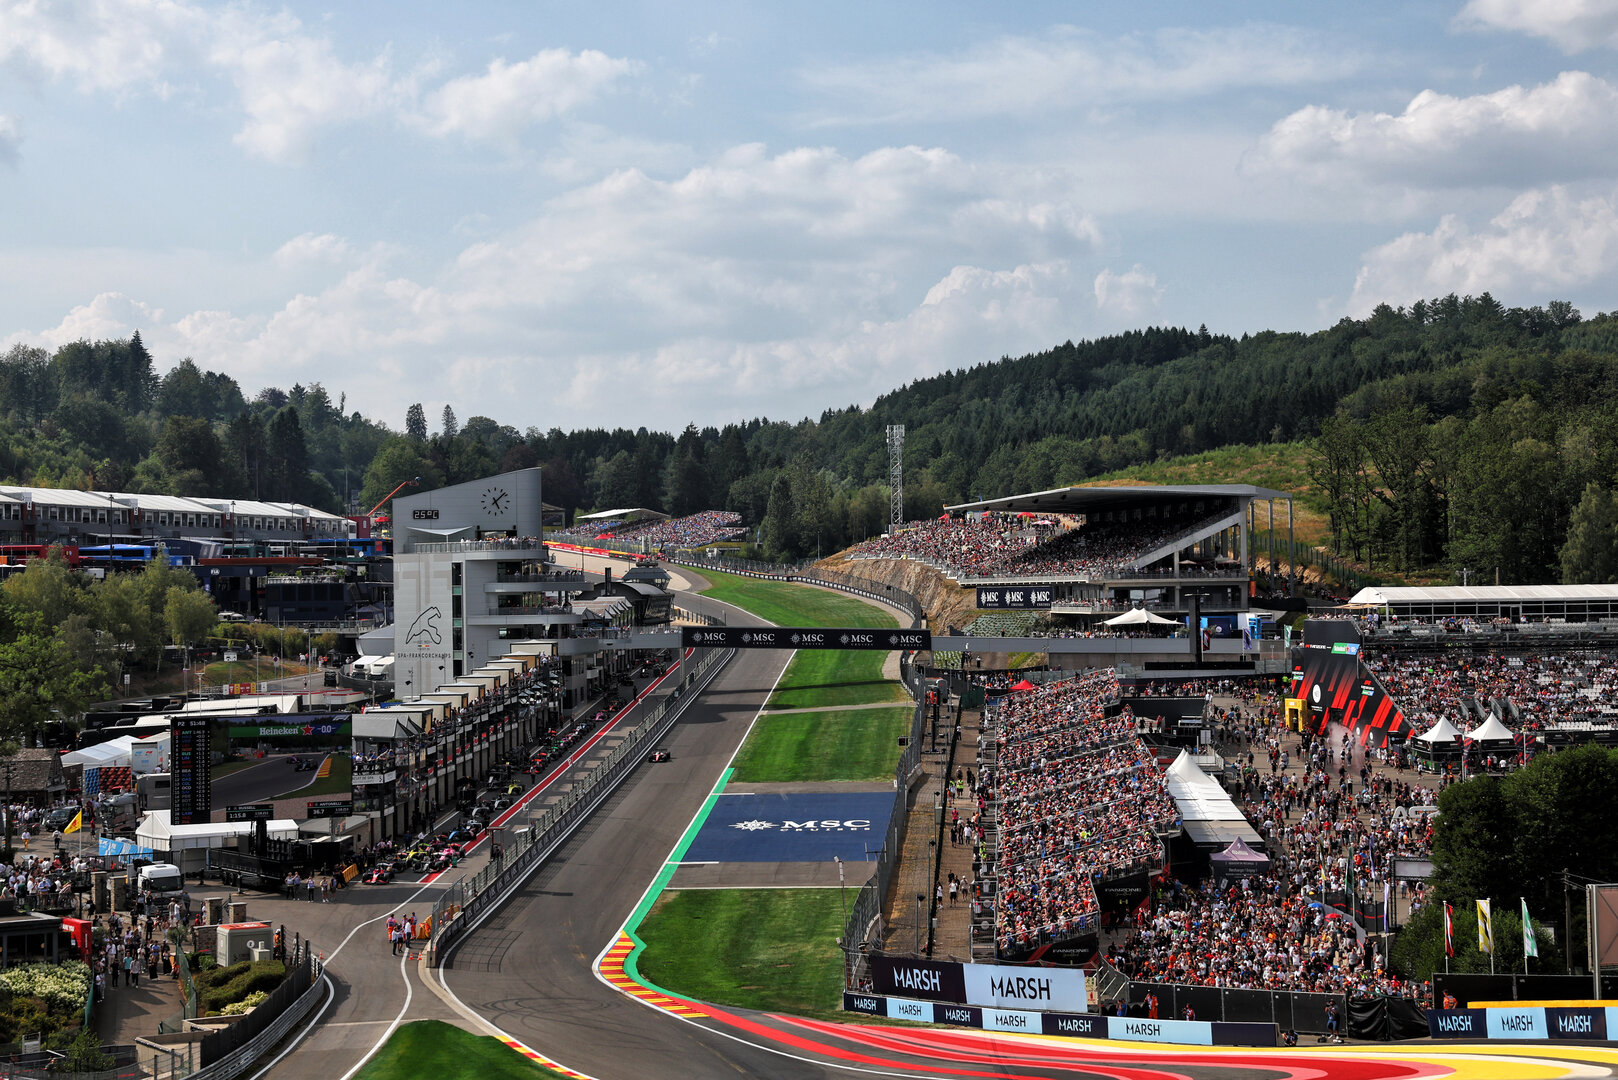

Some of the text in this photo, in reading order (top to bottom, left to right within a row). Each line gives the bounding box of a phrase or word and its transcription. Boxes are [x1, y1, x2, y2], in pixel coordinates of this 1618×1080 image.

[414, 510, 438, 518] 25°C
[987, 592, 998, 601] MSC
[1011, 592, 1024, 601] MSC
[1037, 591, 1050, 601] MSC
[260, 727, 298, 736] Heineken
[781, 820, 870, 828] MSC
[893, 967, 940, 991] MARSH
[991, 975, 1050, 1000] MARSH
[854, 998, 877, 1010] MARSH
[898, 1004, 922, 1016] MARSH
[945, 1009, 970, 1022] MARSH
[995, 1015, 1026, 1027] MARSH
[1058, 1019, 1091, 1032] MARSH
[1126, 1023, 1160, 1036] MARSH
[1438, 1016, 1472, 1031] MARSH
[1501, 1016, 1533, 1031] MARSH
[1558, 1015, 1592, 1032] MARSH
